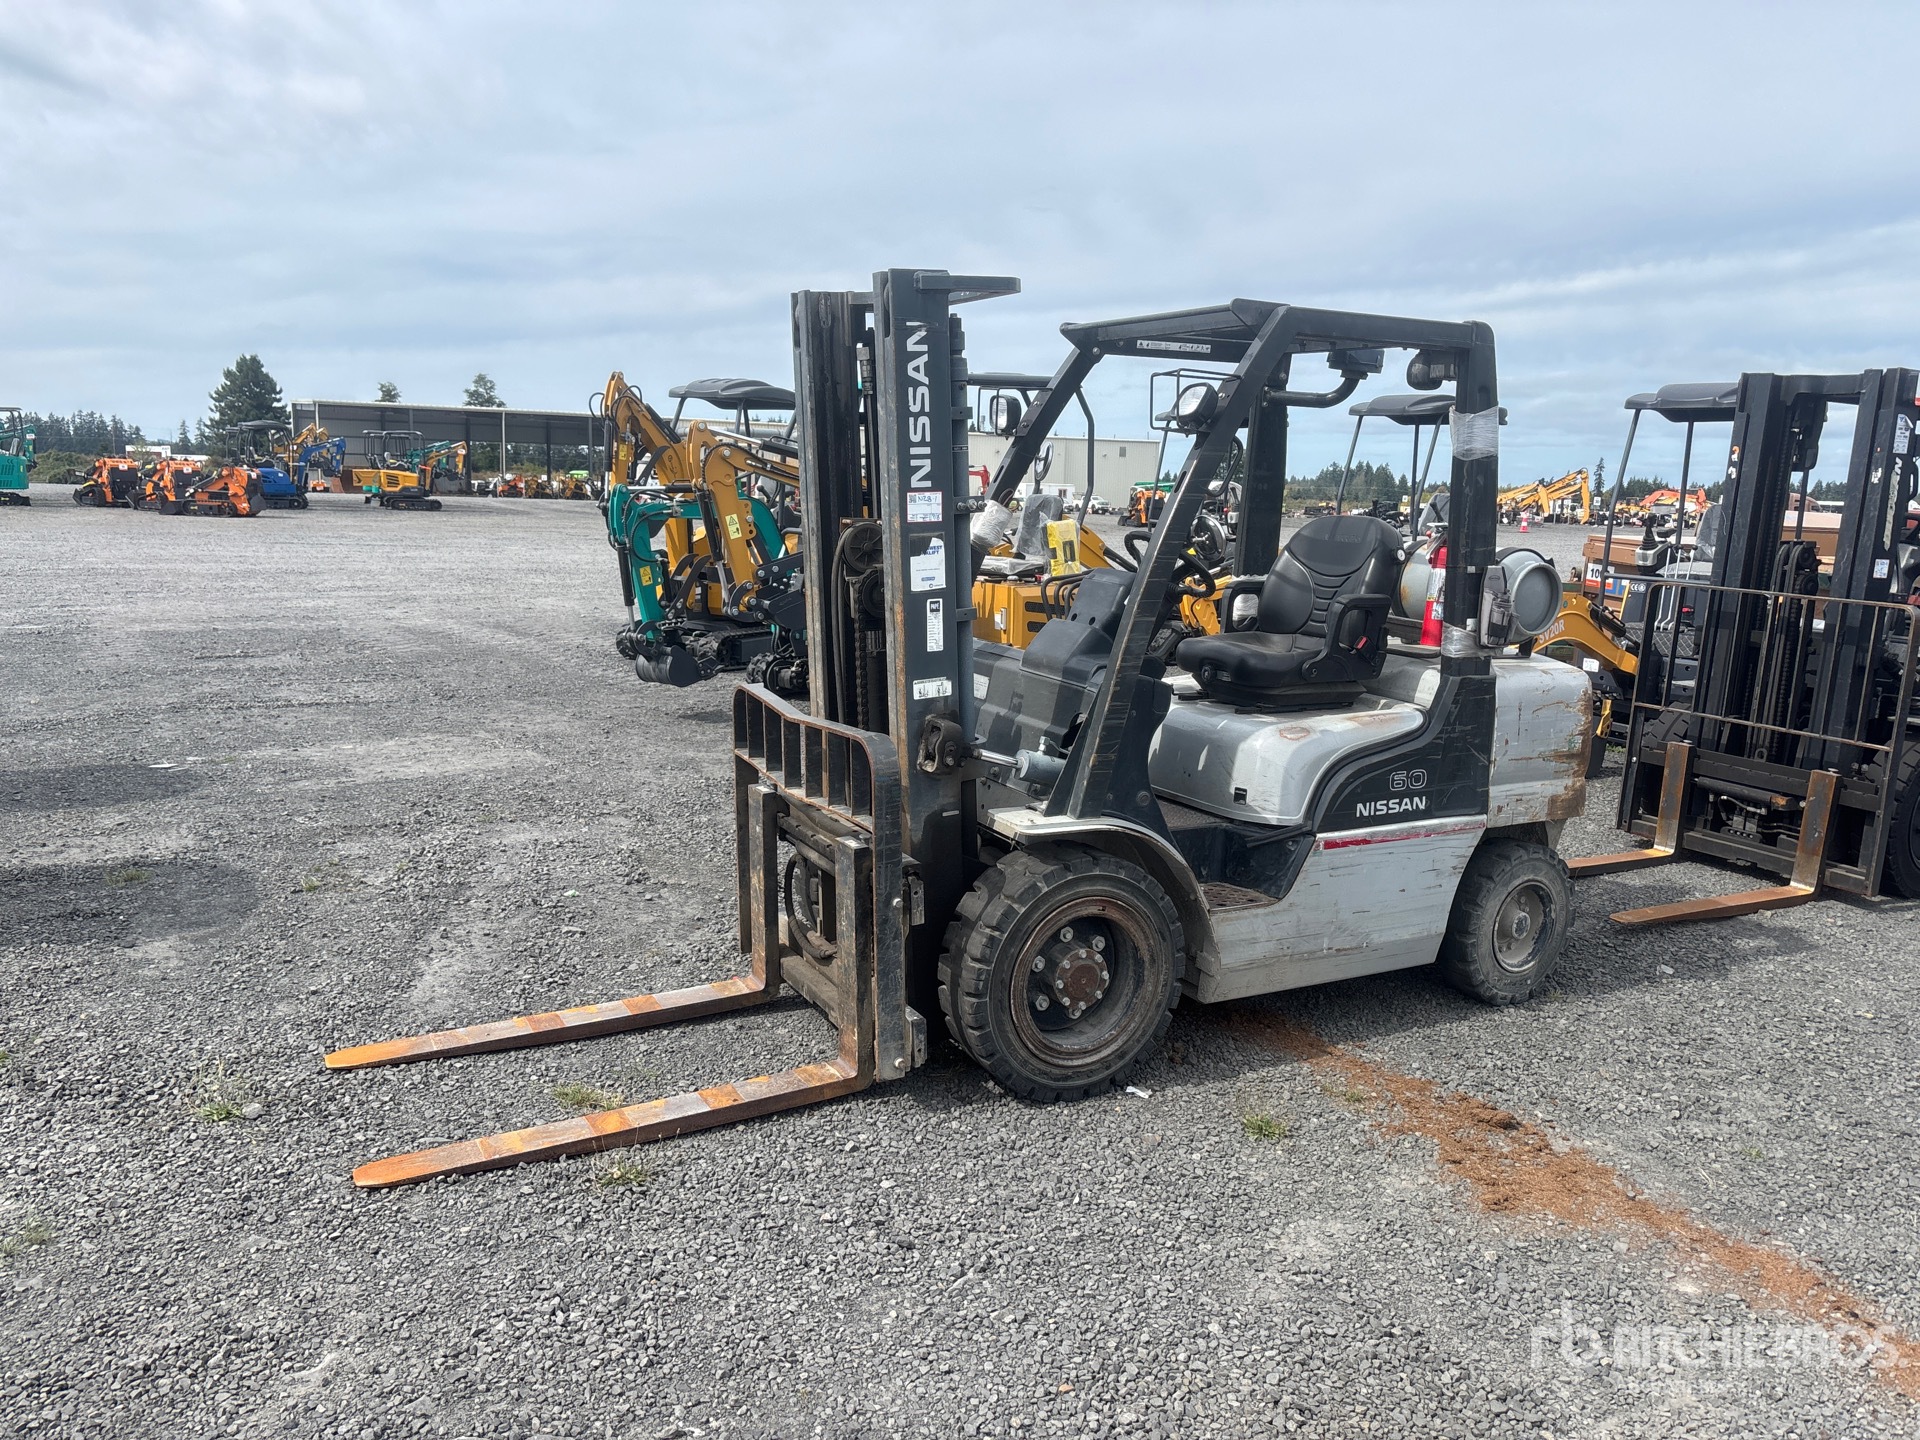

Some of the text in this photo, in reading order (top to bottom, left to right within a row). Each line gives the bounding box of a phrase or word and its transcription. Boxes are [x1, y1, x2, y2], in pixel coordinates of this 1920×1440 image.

[905, 321, 934, 489] NISSAN
[1538, 619, 1566, 644] SV20R
[1389, 768, 1428, 791] 60
[1356, 796, 1426, 818] NISSAN
